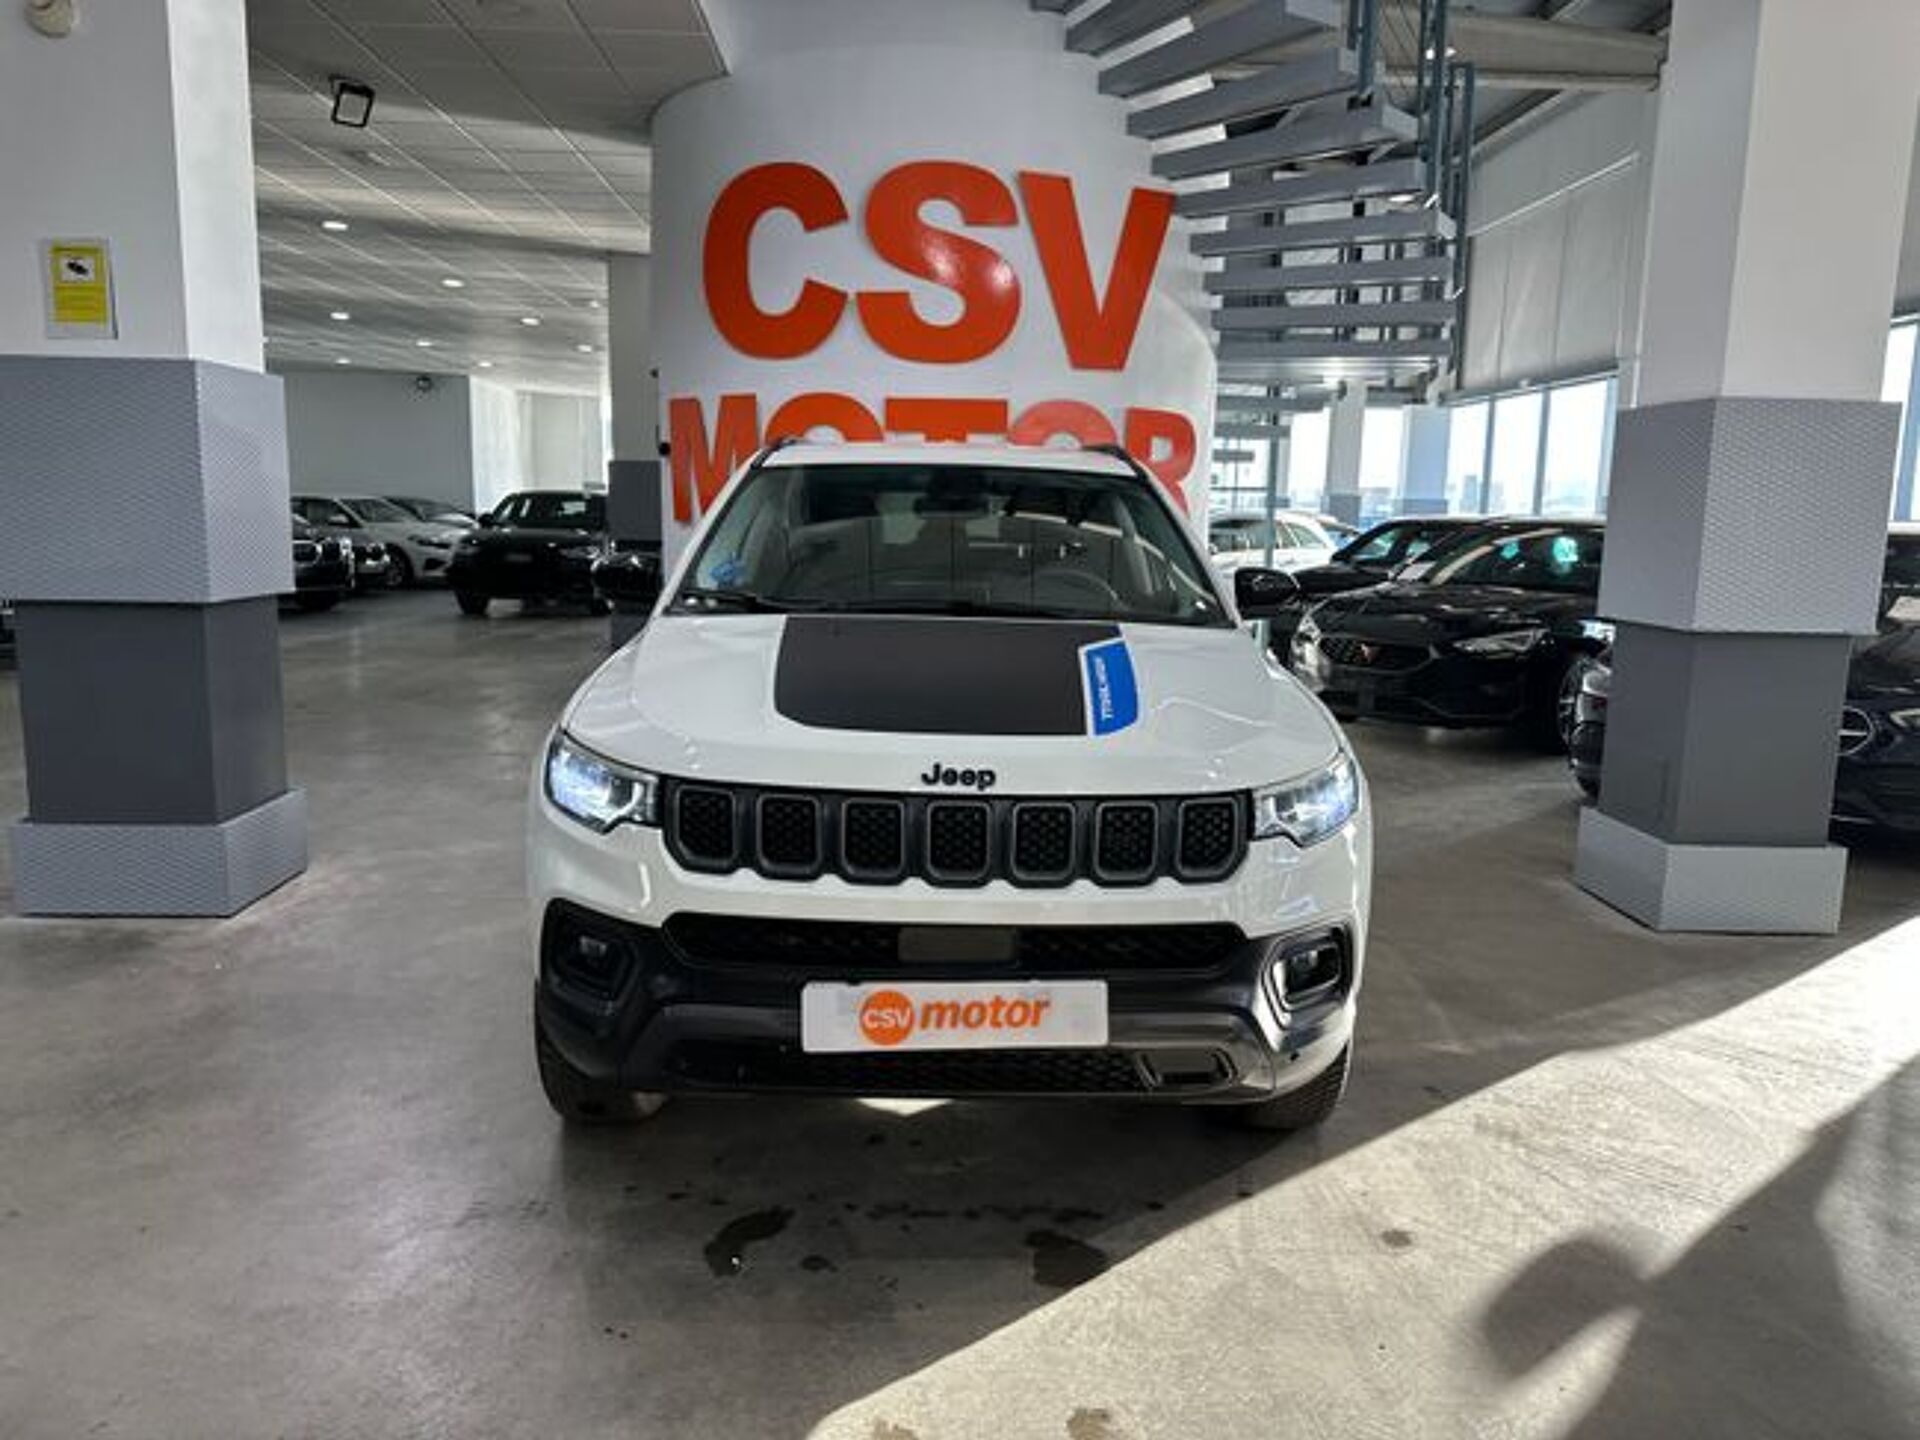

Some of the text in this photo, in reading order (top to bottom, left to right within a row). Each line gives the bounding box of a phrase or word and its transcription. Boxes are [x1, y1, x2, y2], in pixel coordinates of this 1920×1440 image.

[703, 160, 1176, 371] CSV
[921, 762, 996, 792] Jeep
[919, 995, 1050, 1030] motor
